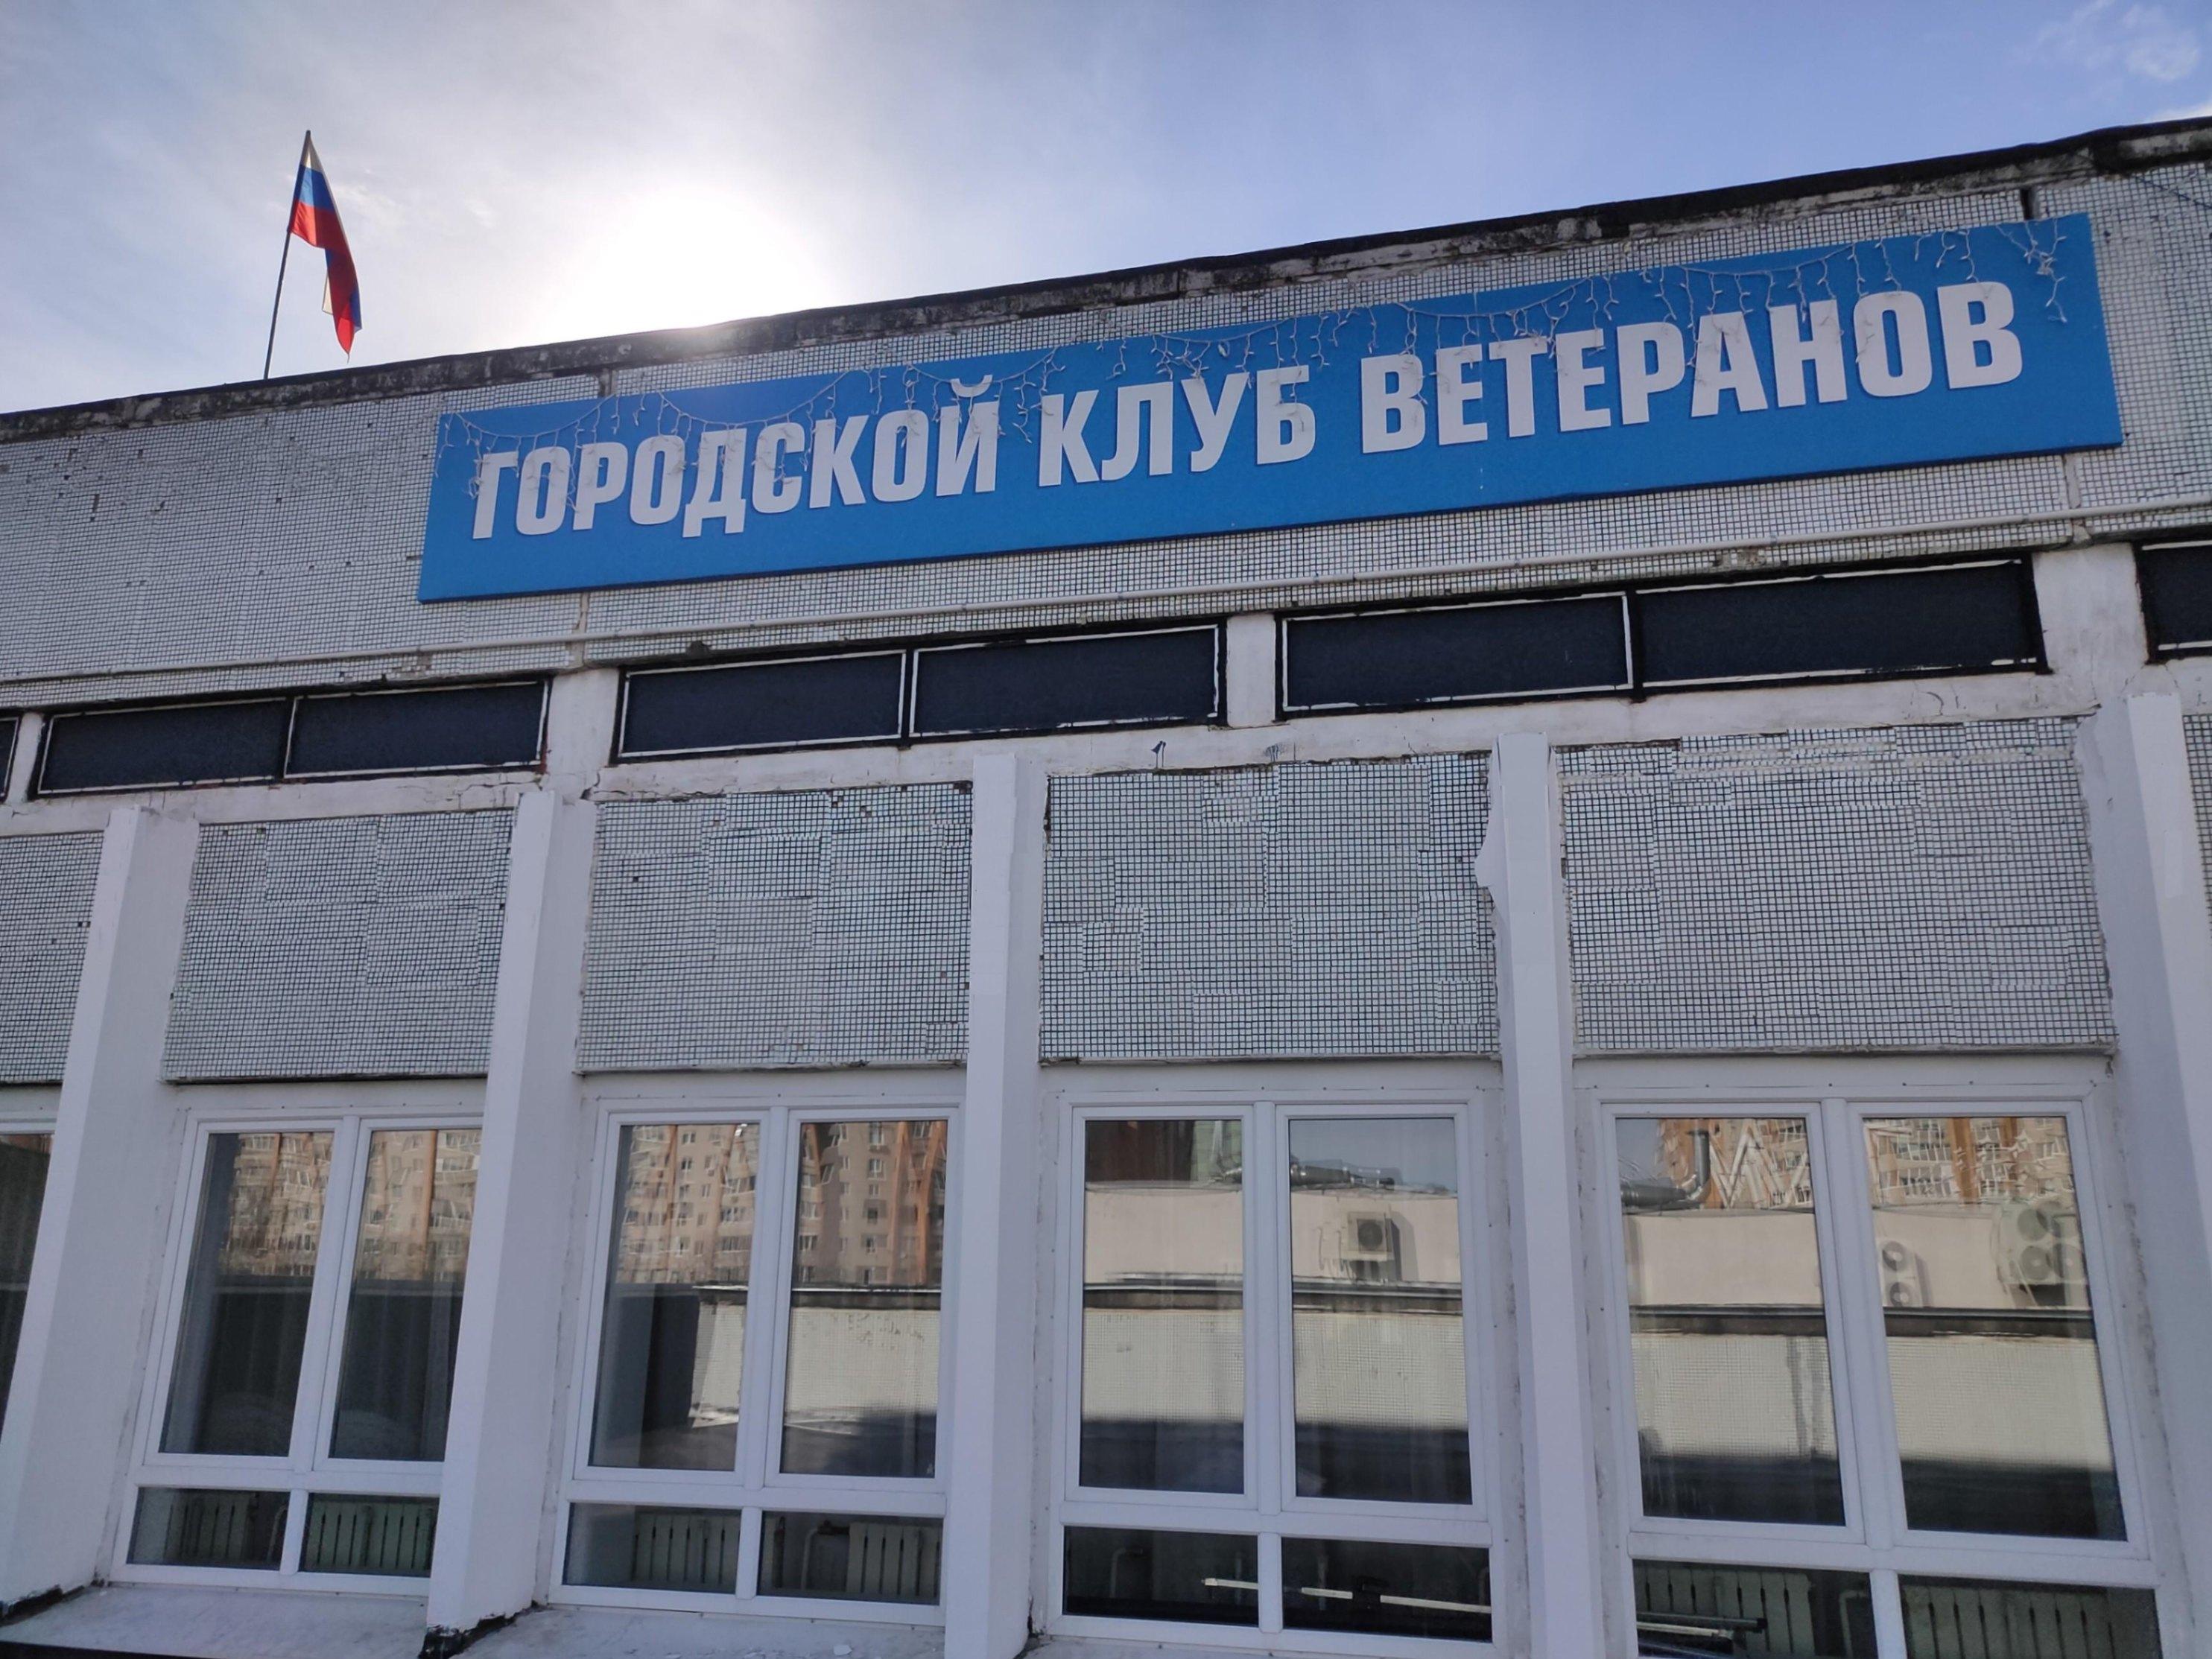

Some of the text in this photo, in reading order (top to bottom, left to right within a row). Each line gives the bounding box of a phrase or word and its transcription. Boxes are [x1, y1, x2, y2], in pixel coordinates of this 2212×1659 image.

[472, 281, 2023, 539] ГОРОДСКОЙ КЛУБ ВЕТЕРАНОВ
